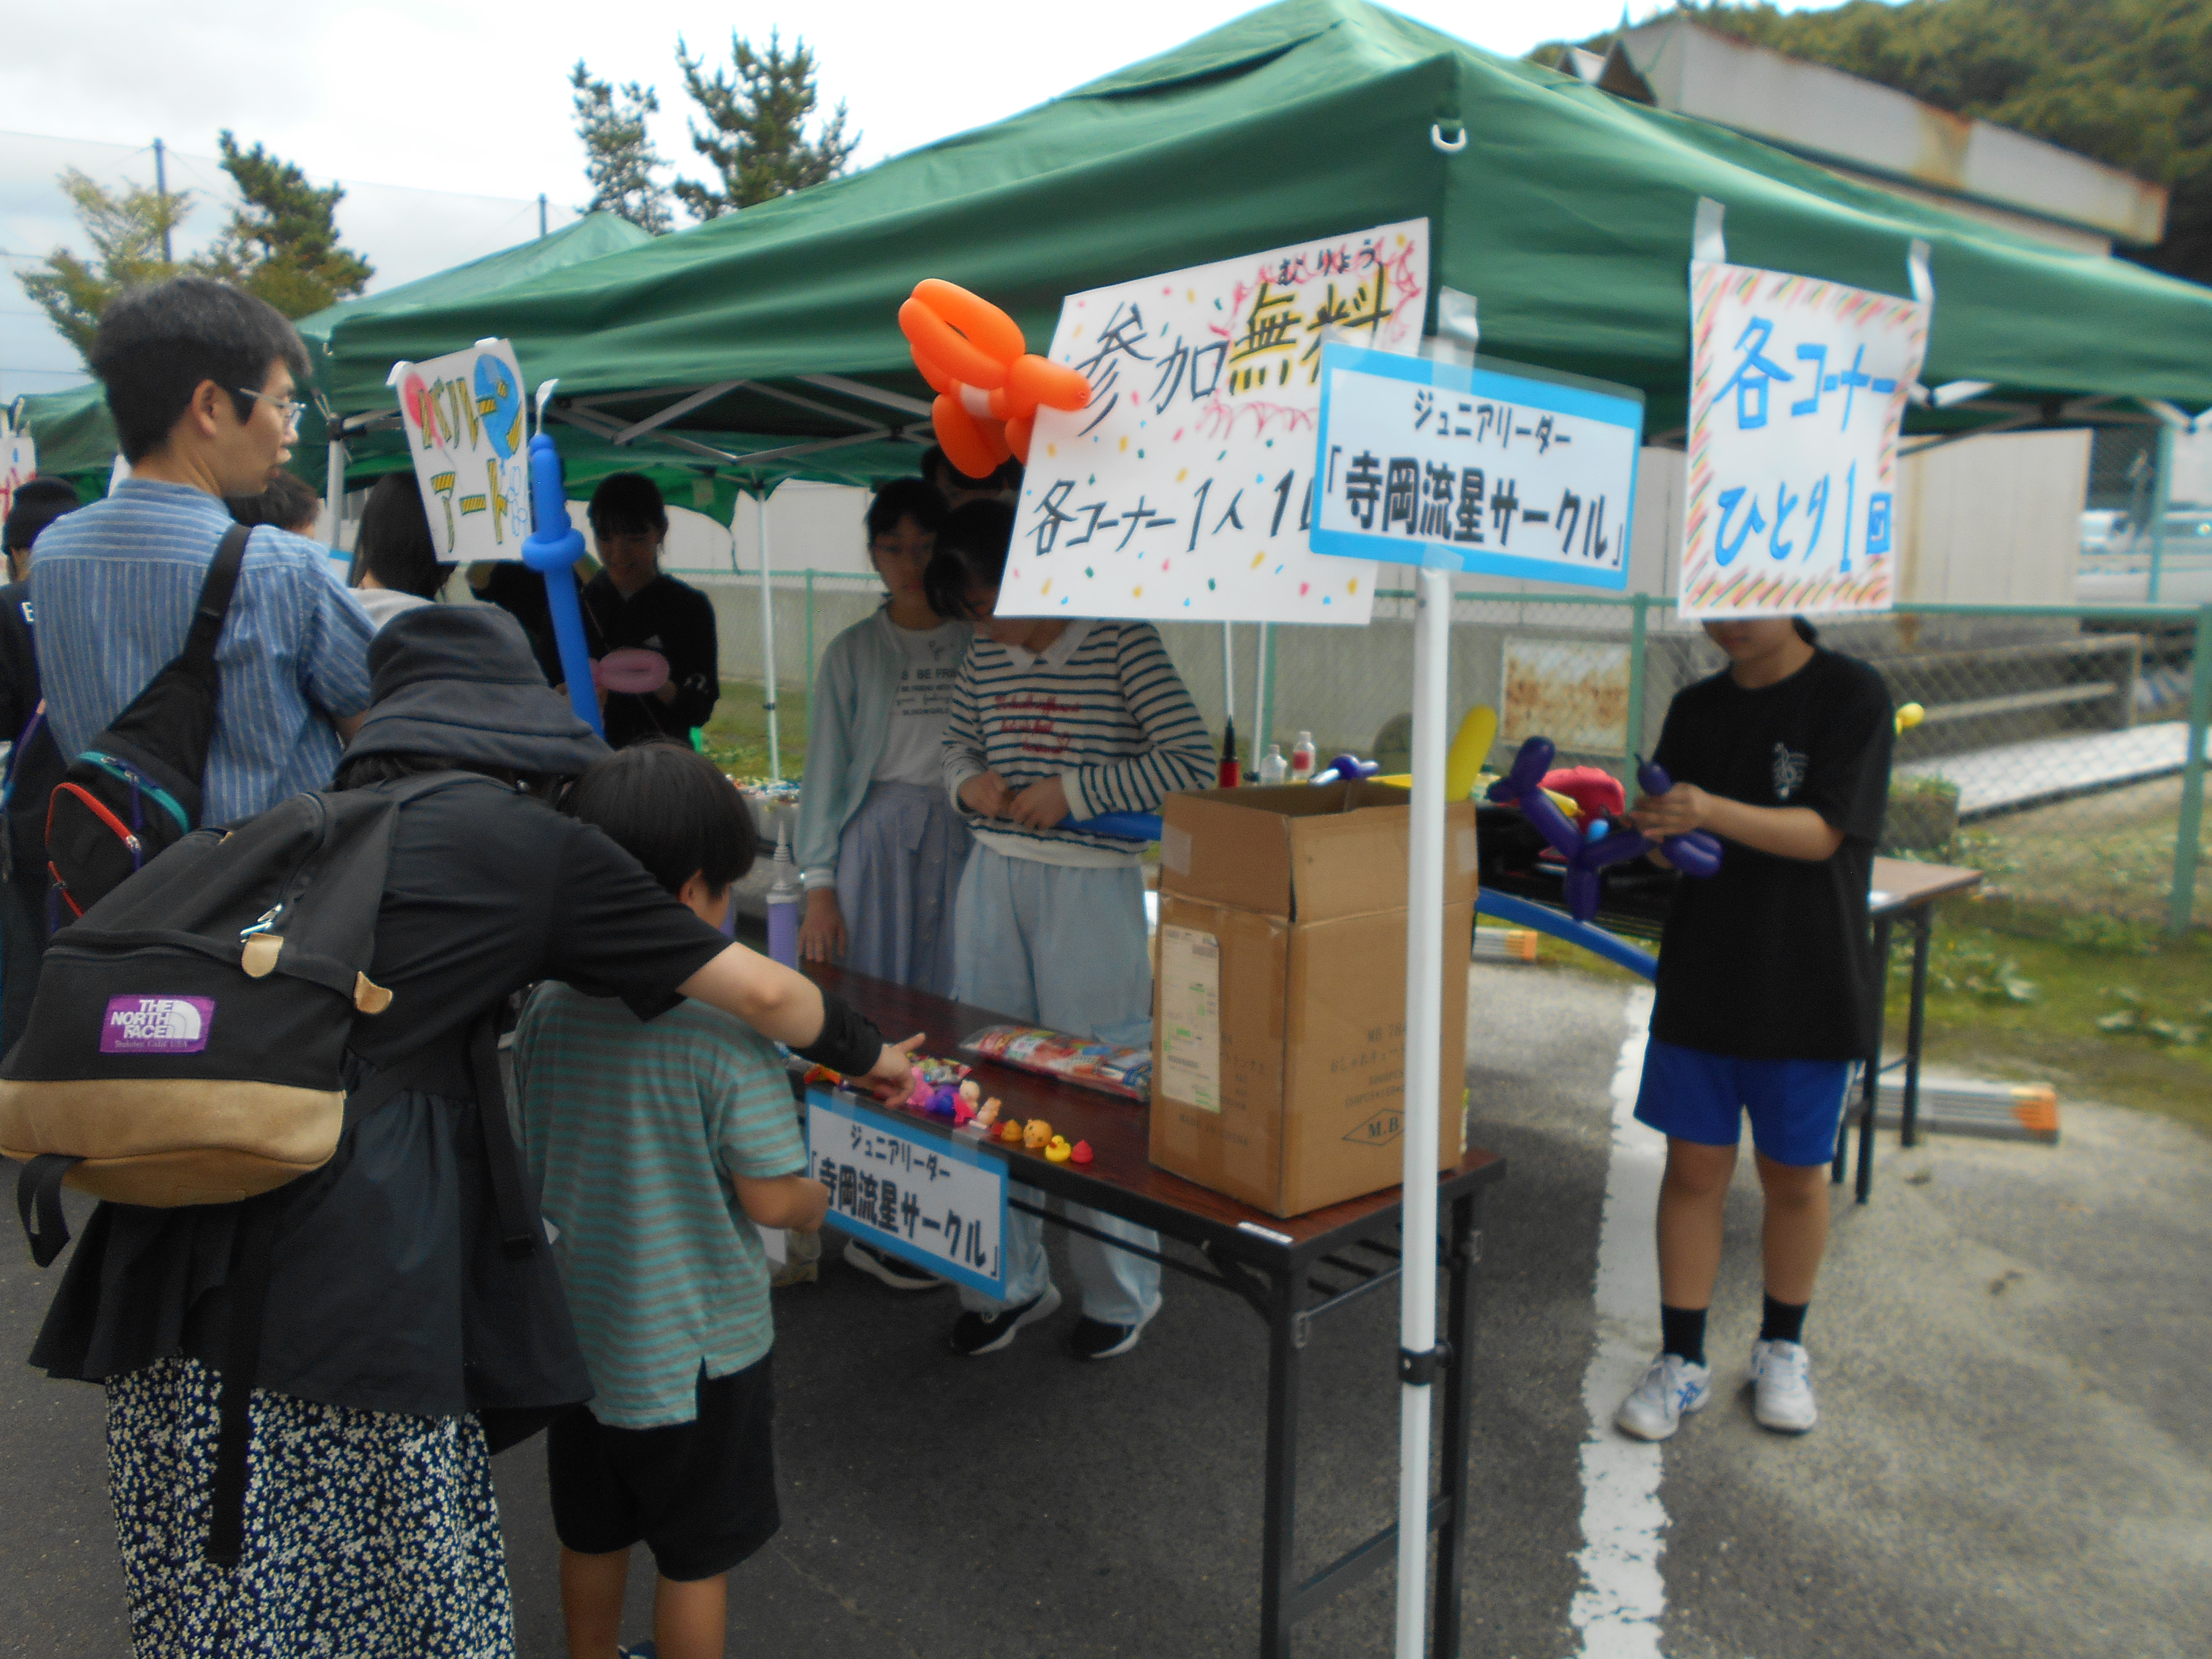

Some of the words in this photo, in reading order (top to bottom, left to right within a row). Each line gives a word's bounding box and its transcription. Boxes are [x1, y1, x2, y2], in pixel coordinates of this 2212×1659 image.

[1711, 316, 1898, 433] 各コーナー
[1413, 389, 1571, 455] ジュニアリーダー
[431, 458, 508, 553] アート
[1026, 469, 1314, 556] 各コーナー1人1
[1328, 444, 1624, 567] 「寺岡流星サークル」
[111, 1012, 170, 1025] NORTH
[124, 1025, 168, 1039] FACE
[140, 1000, 173, 1012] THE
[851, 1124, 951, 1181] ジュニアリーダー
